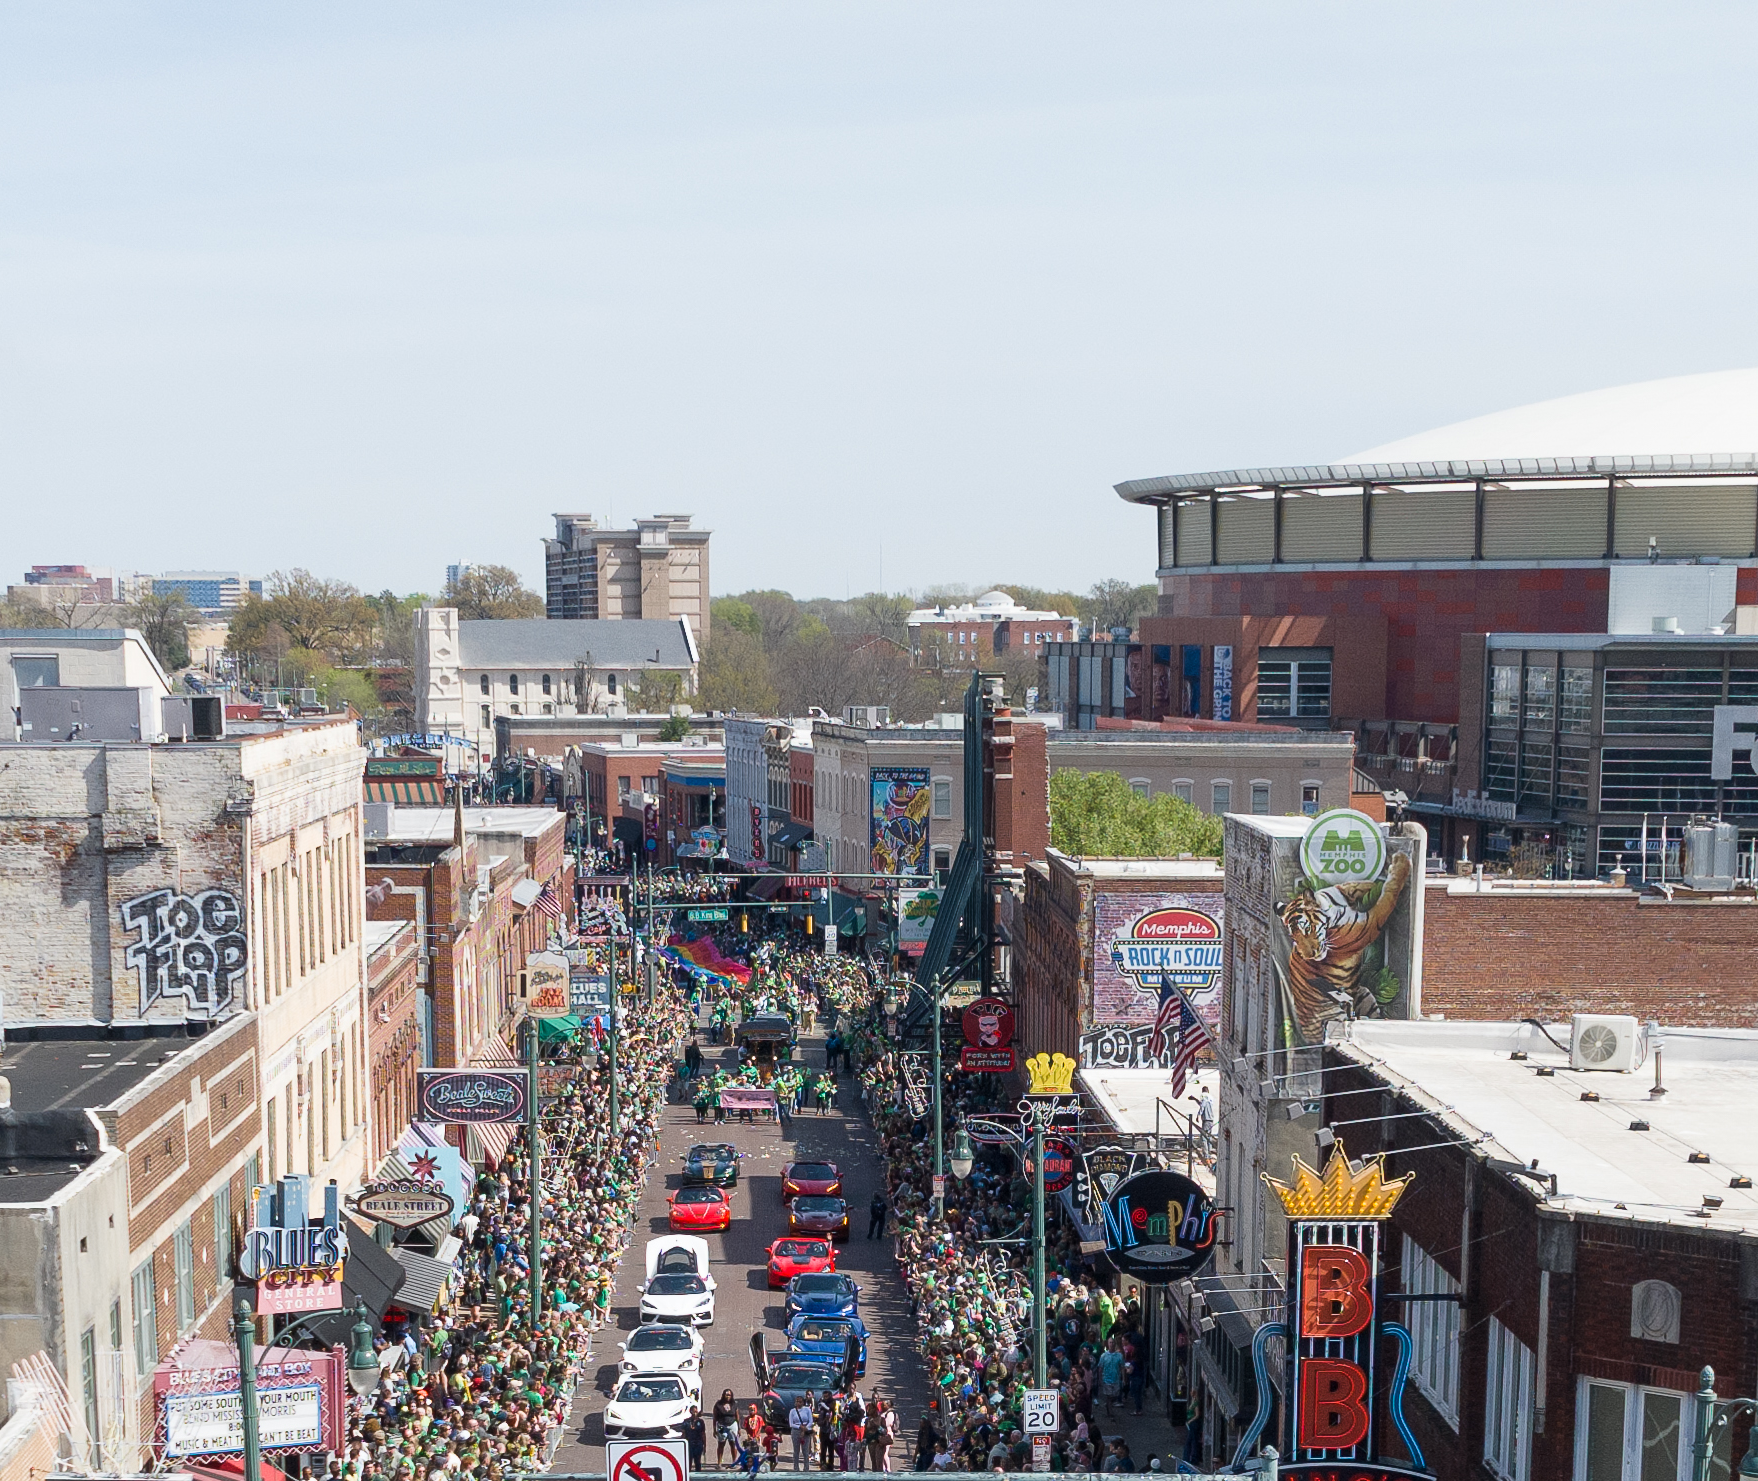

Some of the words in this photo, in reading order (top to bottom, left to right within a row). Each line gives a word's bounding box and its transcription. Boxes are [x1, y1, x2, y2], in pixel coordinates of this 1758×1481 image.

[1320, 859, 1365, 874] ZOO
[1142, 922, 1212, 939] Memphis
[1128, 947, 1170, 966] ROCK
[1174, 951, 1181, 964] n
[570, 982, 606, 993] LUES
[970, 1003, 1007, 1017] PIG
[430, 1082, 476, 1104] Beale
[366, 1201, 400, 1211] BEALE
[403, 1201, 444, 1211] STREET
[253, 1225, 339, 1278] BLUES
[267, 1266, 340, 1287] CITY
[264, 1286, 335, 1299] GENERAL
[1301, 1244, 1373, 1338] B
[276, 1298, 324, 1310] STORE
[256, 1364, 281, 1377] AND
[284, 1362, 312, 1376] BOX
[286, 1390, 317, 1402] MOUTH
[1300, 1357, 1370, 1449] B
[262, 1405, 296, 1417] MORRIS
[1028, 1411, 1055, 1427] 20
[175, 1438, 199, 1450] MUSIC
[203, 1437, 208, 1448] &
[212, 1435, 233, 1447] MEAT
[285, 1429, 294, 1440] BE
[297, 1428, 316, 1440] BEAT
